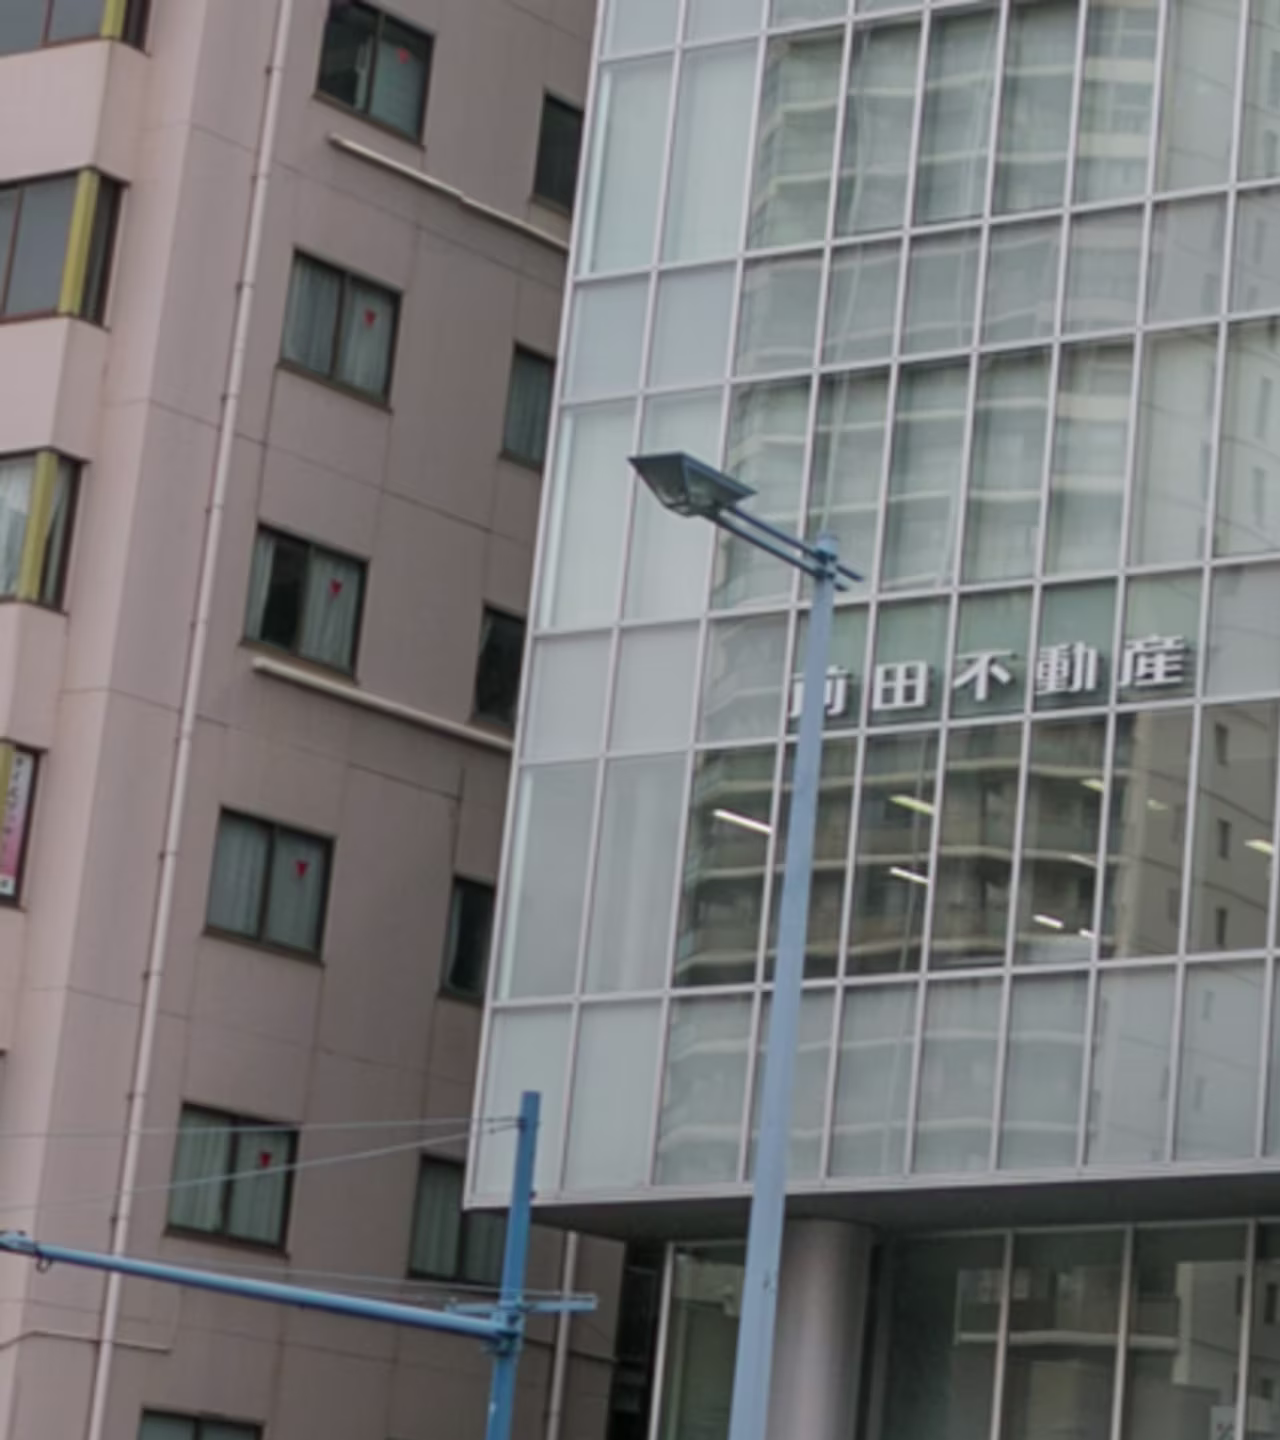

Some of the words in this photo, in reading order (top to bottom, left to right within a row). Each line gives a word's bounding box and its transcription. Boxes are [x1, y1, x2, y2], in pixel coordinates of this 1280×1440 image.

[789, 635, 1185, 718] 前田不動産
